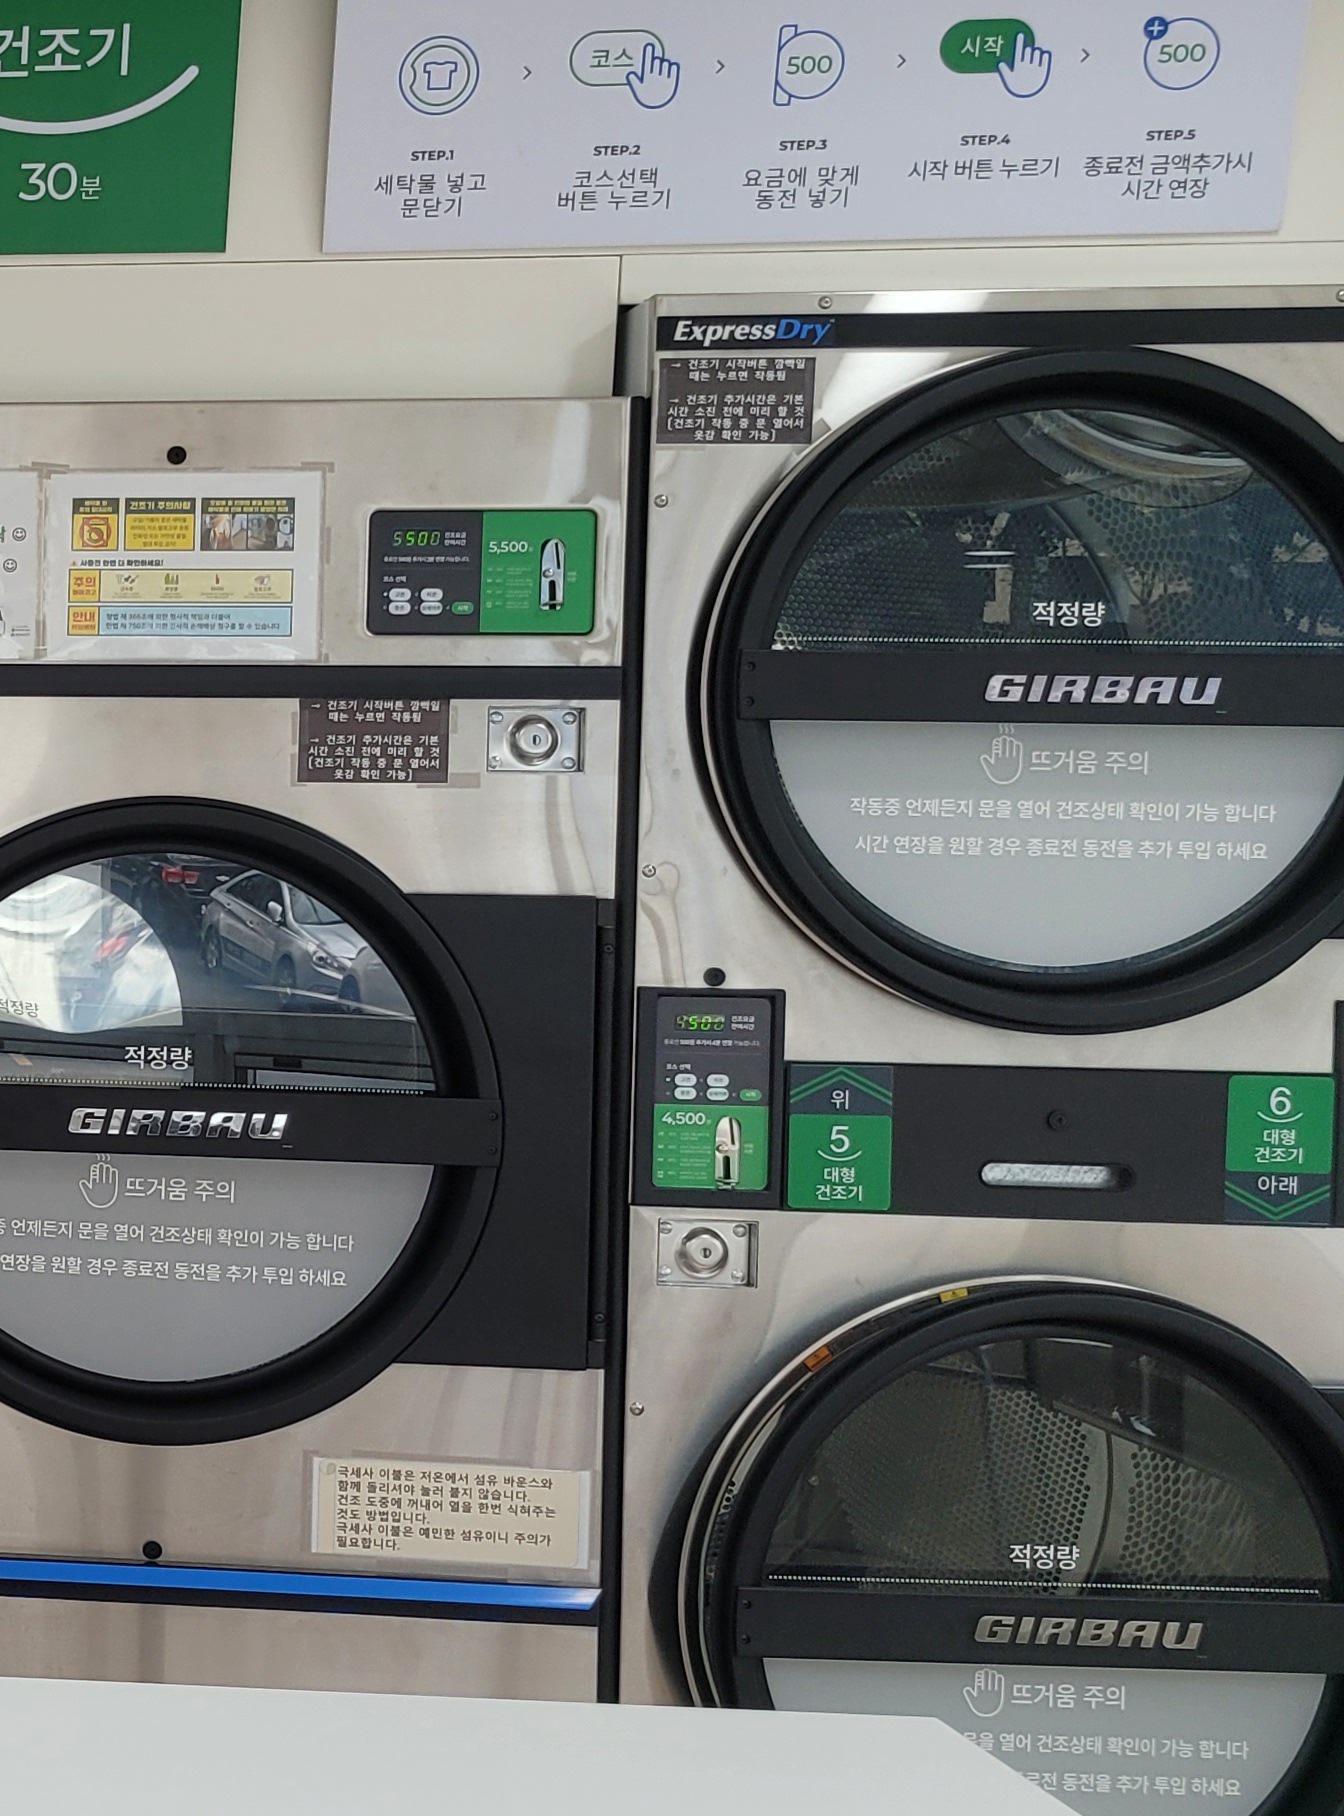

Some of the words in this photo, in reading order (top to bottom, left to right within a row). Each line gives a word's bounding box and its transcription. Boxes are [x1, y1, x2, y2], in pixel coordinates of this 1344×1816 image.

[961, 35, 1004, 57] 시작
[1157, 43, 1206, 63] 500
[589, 48, 634, 68] 코스
[785, 55, 833, 75] 500
[907, 159, 949, 181] 시작
[954, 158, 993, 180] 버튼
[999, 156, 1059, 179] 누르기
[1083, 154, 1144, 177] 종료전
[1150, 151, 1252, 175] 금액추가시
[374, 173, 436, 195] 세탁물
[447, 172, 486, 194] 넣고
[572, 167, 658, 189] 코스선택
[1121, 178, 1163, 200] 시간
[1168, 177, 1209, 199] 연장
[400, 196, 462, 218] 문닫기
[557, 190, 598, 212] 버튼
[607, 188, 670, 211] 누르기
[1032, 601, 1105, 627] 적정량
[983, 673, 1223, 706] GIRBAU
[123, 1045, 192, 1072] 적정량
[831, 1089, 849, 1109] 위
[1268, 1085, 1291, 1115] 6
[67, 1107, 288, 1141] GIRBAU
[830, 1125, 850, 1153] 5
[1262, 1128, 1296, 1146] 대형
[1253, 1147, 1303, 1165] 건조기
[823, 1166, 855, 1183] 대형
[1258, 1175, 1297, 1195] 아래
[124, 1176, 188, 1201] 뜨거움
[193, 1178, 236, 1203] 주의
[816, 1184, 862, 1201] 건조기
[9, 1217, 73, 1239] 언제든지
[77, 1220, 109, 1241] 문을
[113, 1223, 144, 1242] 열어
[149, 1224, 212, 1245] 건조상태
[216, 1228, 264, 1248] 확인이
[269, 1231, 301, 1249] 가능
[305, 1232, 354, 1252] 합니다
[337, 1466, 374, 1479] 극세사
[379, 1468, 415, 1482] 이불은
[420, 1470, 468, 1484] 저온에서
[474, 1474, 498, 1487] 섬유
[1009, 1544, 1080, 1570] 적정량
[973, 1615, 1204, 1650] GIRBAU
